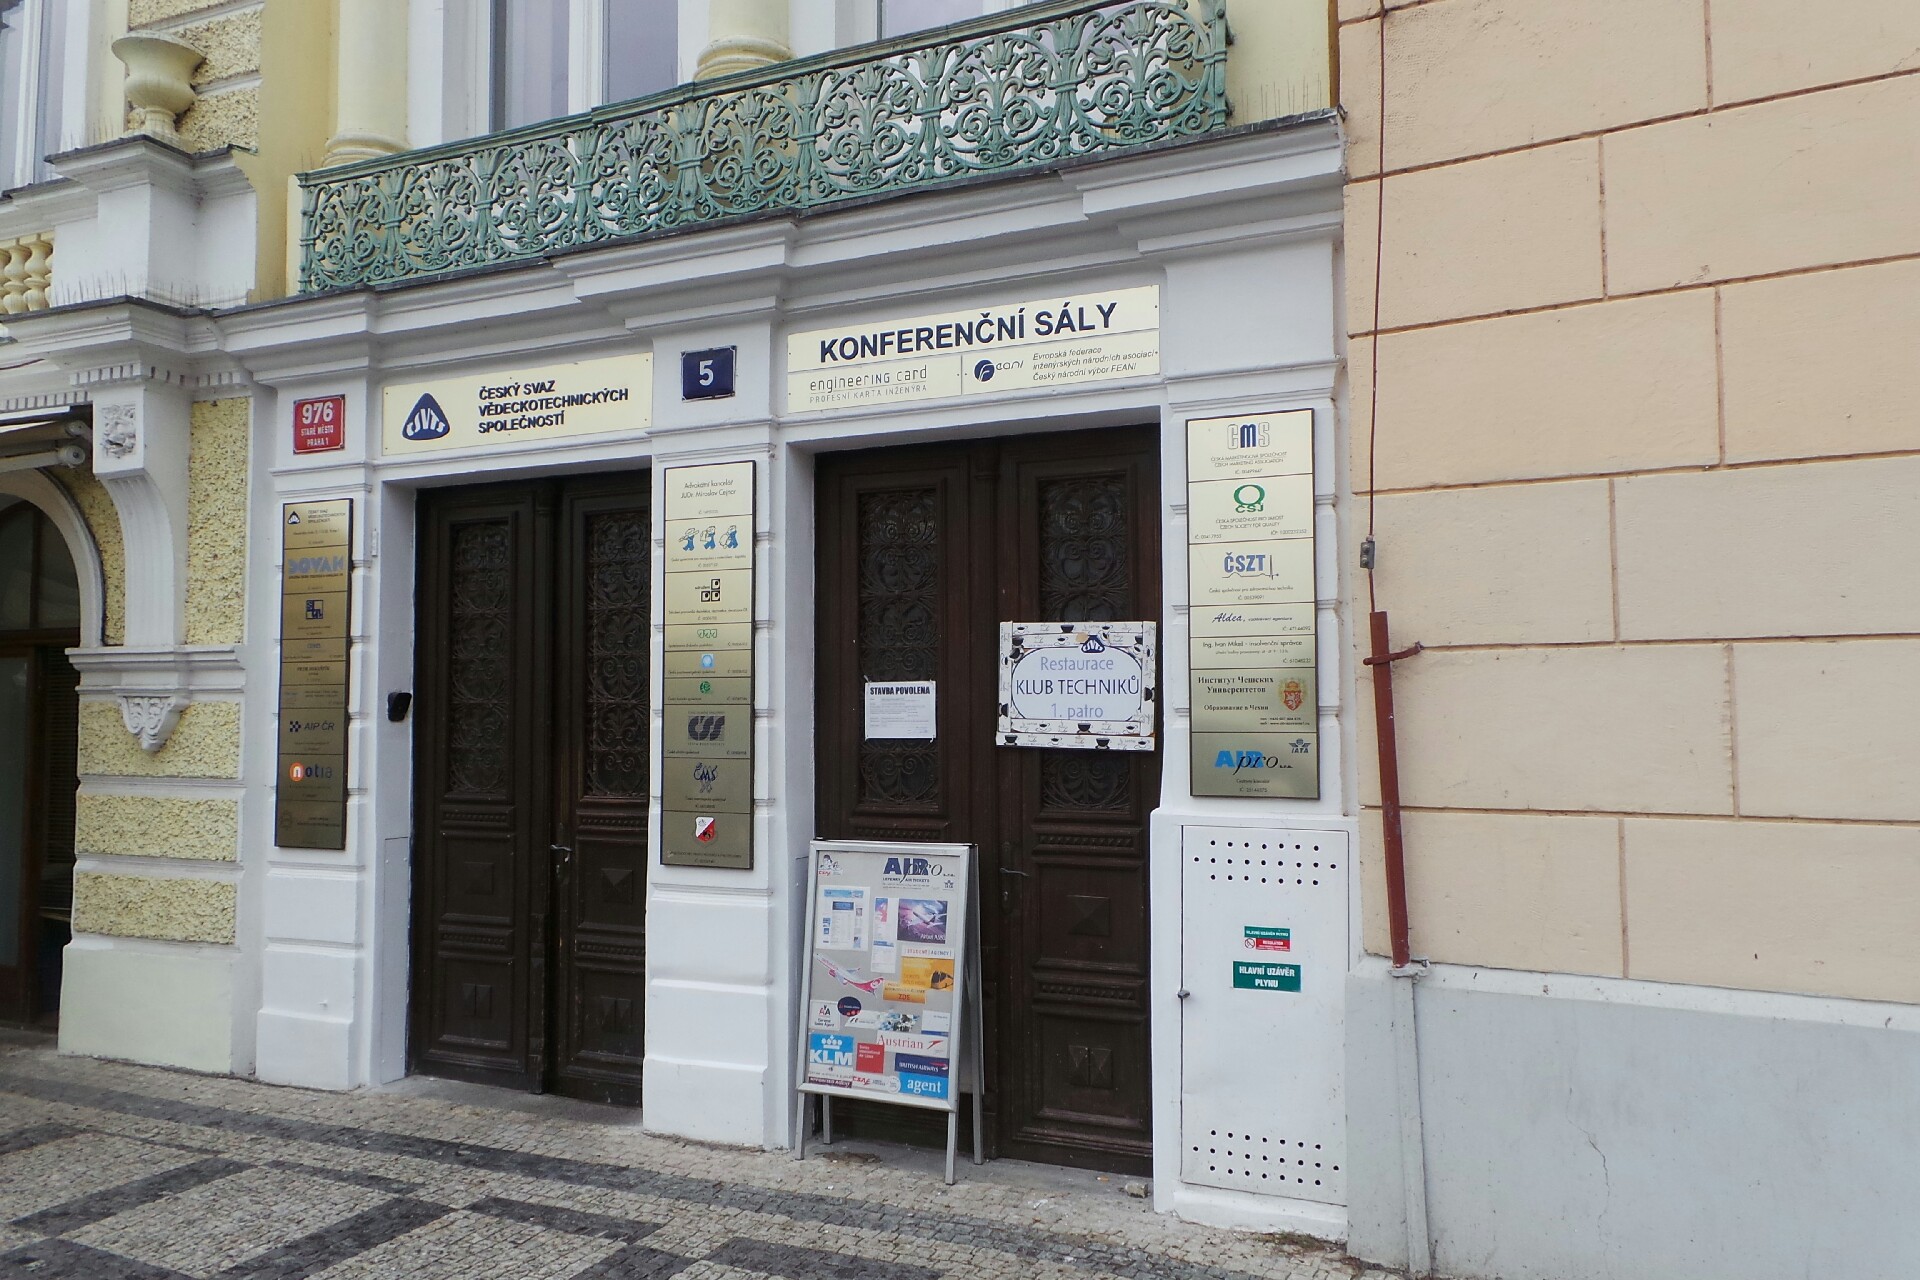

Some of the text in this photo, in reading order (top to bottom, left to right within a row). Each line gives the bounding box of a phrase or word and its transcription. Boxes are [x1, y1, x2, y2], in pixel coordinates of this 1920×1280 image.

[820, 301, 1118, 363] KONFERENČNÍ SÁLY
[1033, 349, 1067, 361] Evropská
[699, 359, 714, 386] 5
[897, 364, 927, 382] card
[1032, 371, 1056, 381] Český
[1087, 365, 1109, 376] výbor
[1110, 362, 1137, 373] FEANI
[478, 379, 555, 401] ČESKÝ SVAZ
[853, 389, 884, 399] KARTA
[478, 387, 629, 417] VĚDECKOTECHNICKÝCH
[302, 401, 333, 425] 976
[478, 410, 565, 434] SPOLEČNOSTÍ
[307, 437, 325, 447] PRAHA
[1224, 551, 1266, 573] ČSZT
[1040, 656, 1114, 671] Restaurace
[1016, 674, 1140, 695] KLUB TECHNIKŮ
[1198, 676, 1236, 685] Институт
[869, 686, 931, 696] STAVBA POVOLENA
[1051, 702, 1104, 721] 1. patro
[1239, 965, 1295, 977] HLAVNÍ UZÁVĚR
[1254, 978, 1279, 988] PLYNU
[877, 1034, 924, 1049] Austrian
[809, 1049, 853, 1066] KLM
[907, 1079, 942, 1093] agent
